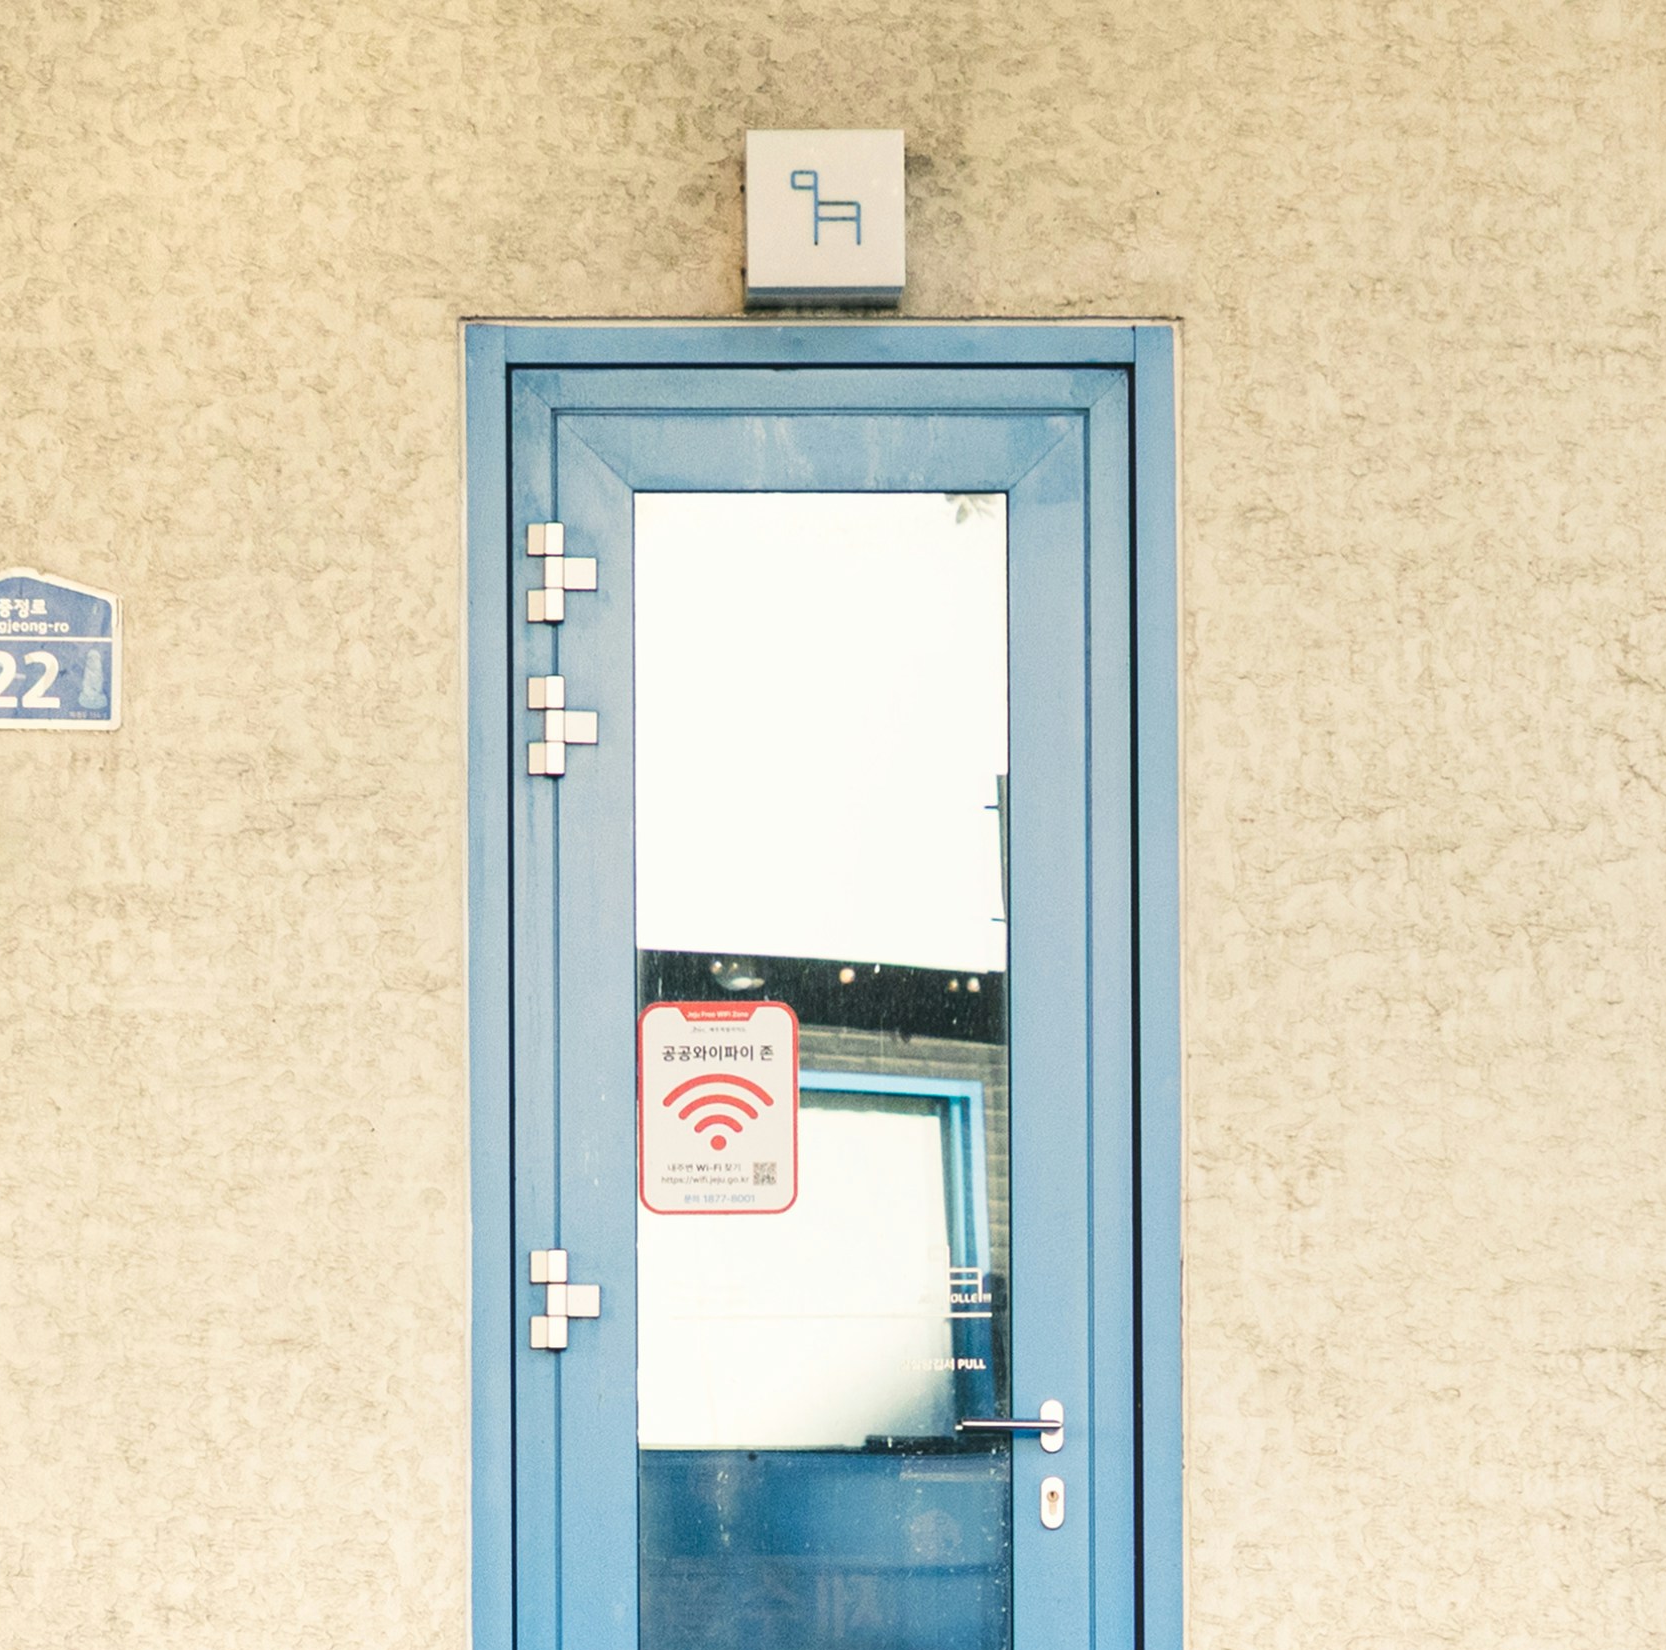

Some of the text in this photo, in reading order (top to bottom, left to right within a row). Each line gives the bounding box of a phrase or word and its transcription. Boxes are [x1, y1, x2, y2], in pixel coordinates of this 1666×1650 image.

[662, 1045, 774, 1062] 공공와이파이 존
[695, 1163, 722, 1172] Wi-Fi
[957, 1358, 987, 1370] PULL
